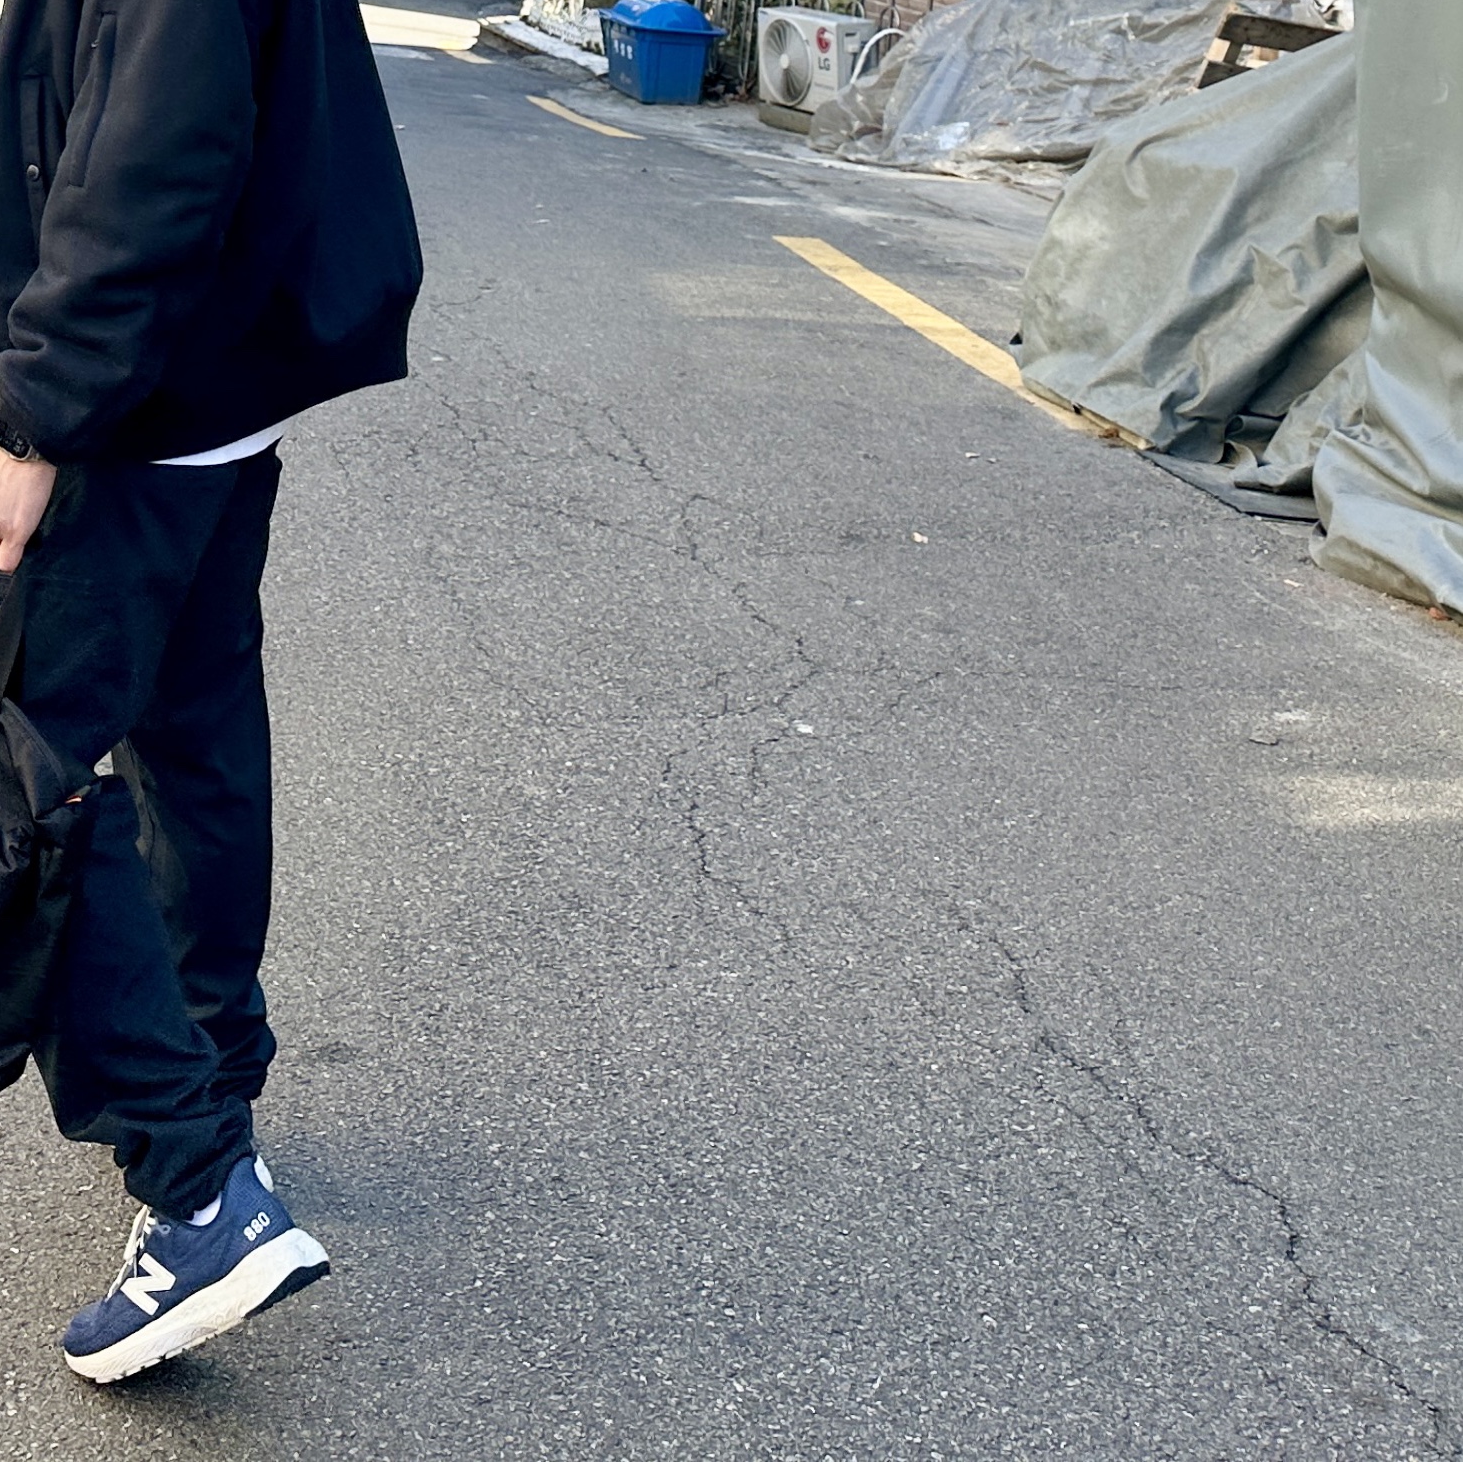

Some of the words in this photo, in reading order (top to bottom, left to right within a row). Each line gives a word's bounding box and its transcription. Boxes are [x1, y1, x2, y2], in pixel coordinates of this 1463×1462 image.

[818, 57, 831, 71] LG
[243, 1211, 271, 1242] 880
[120, 1252, 177, 1316] N
